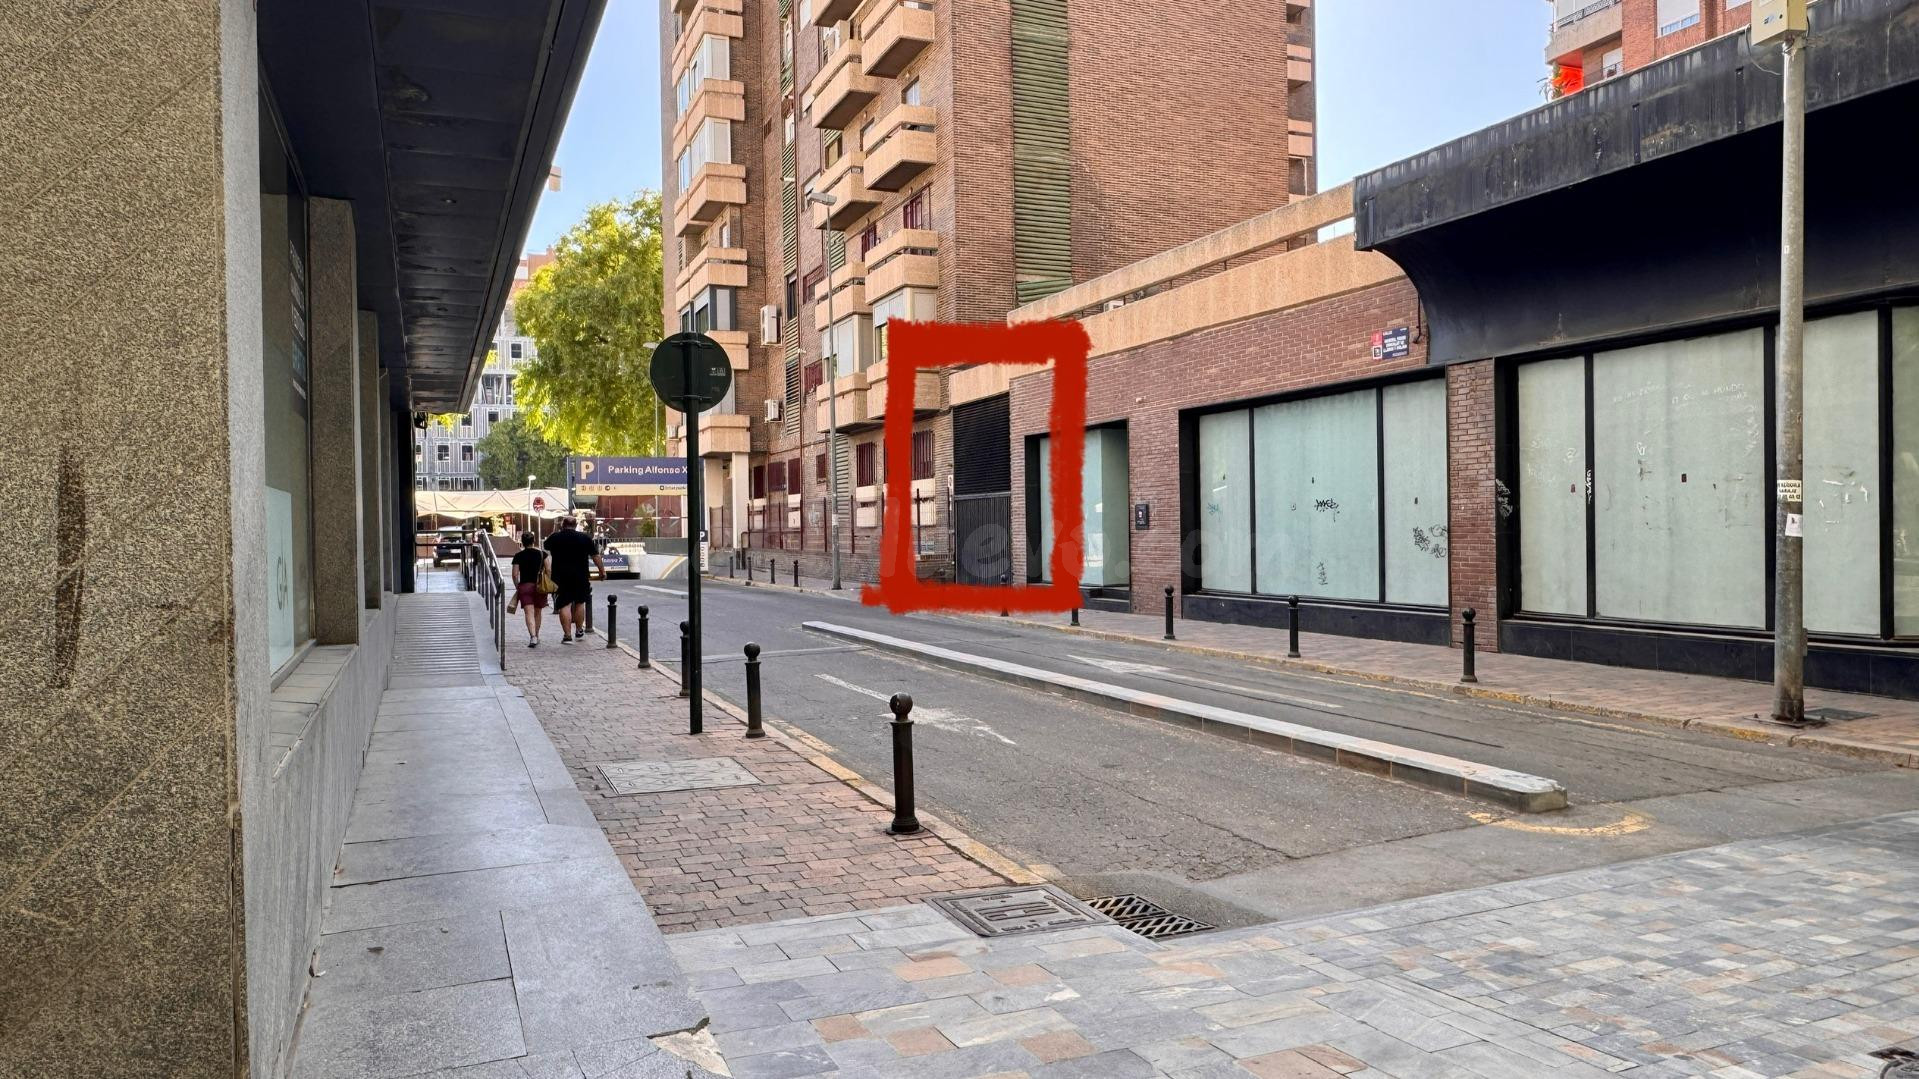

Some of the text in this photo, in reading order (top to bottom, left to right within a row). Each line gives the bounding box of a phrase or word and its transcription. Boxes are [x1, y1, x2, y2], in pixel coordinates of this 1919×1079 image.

[580, 461, 595, 480] P
[608, 465, 644, 475] Parking
[645, 465, 681, 474] Alfonso
